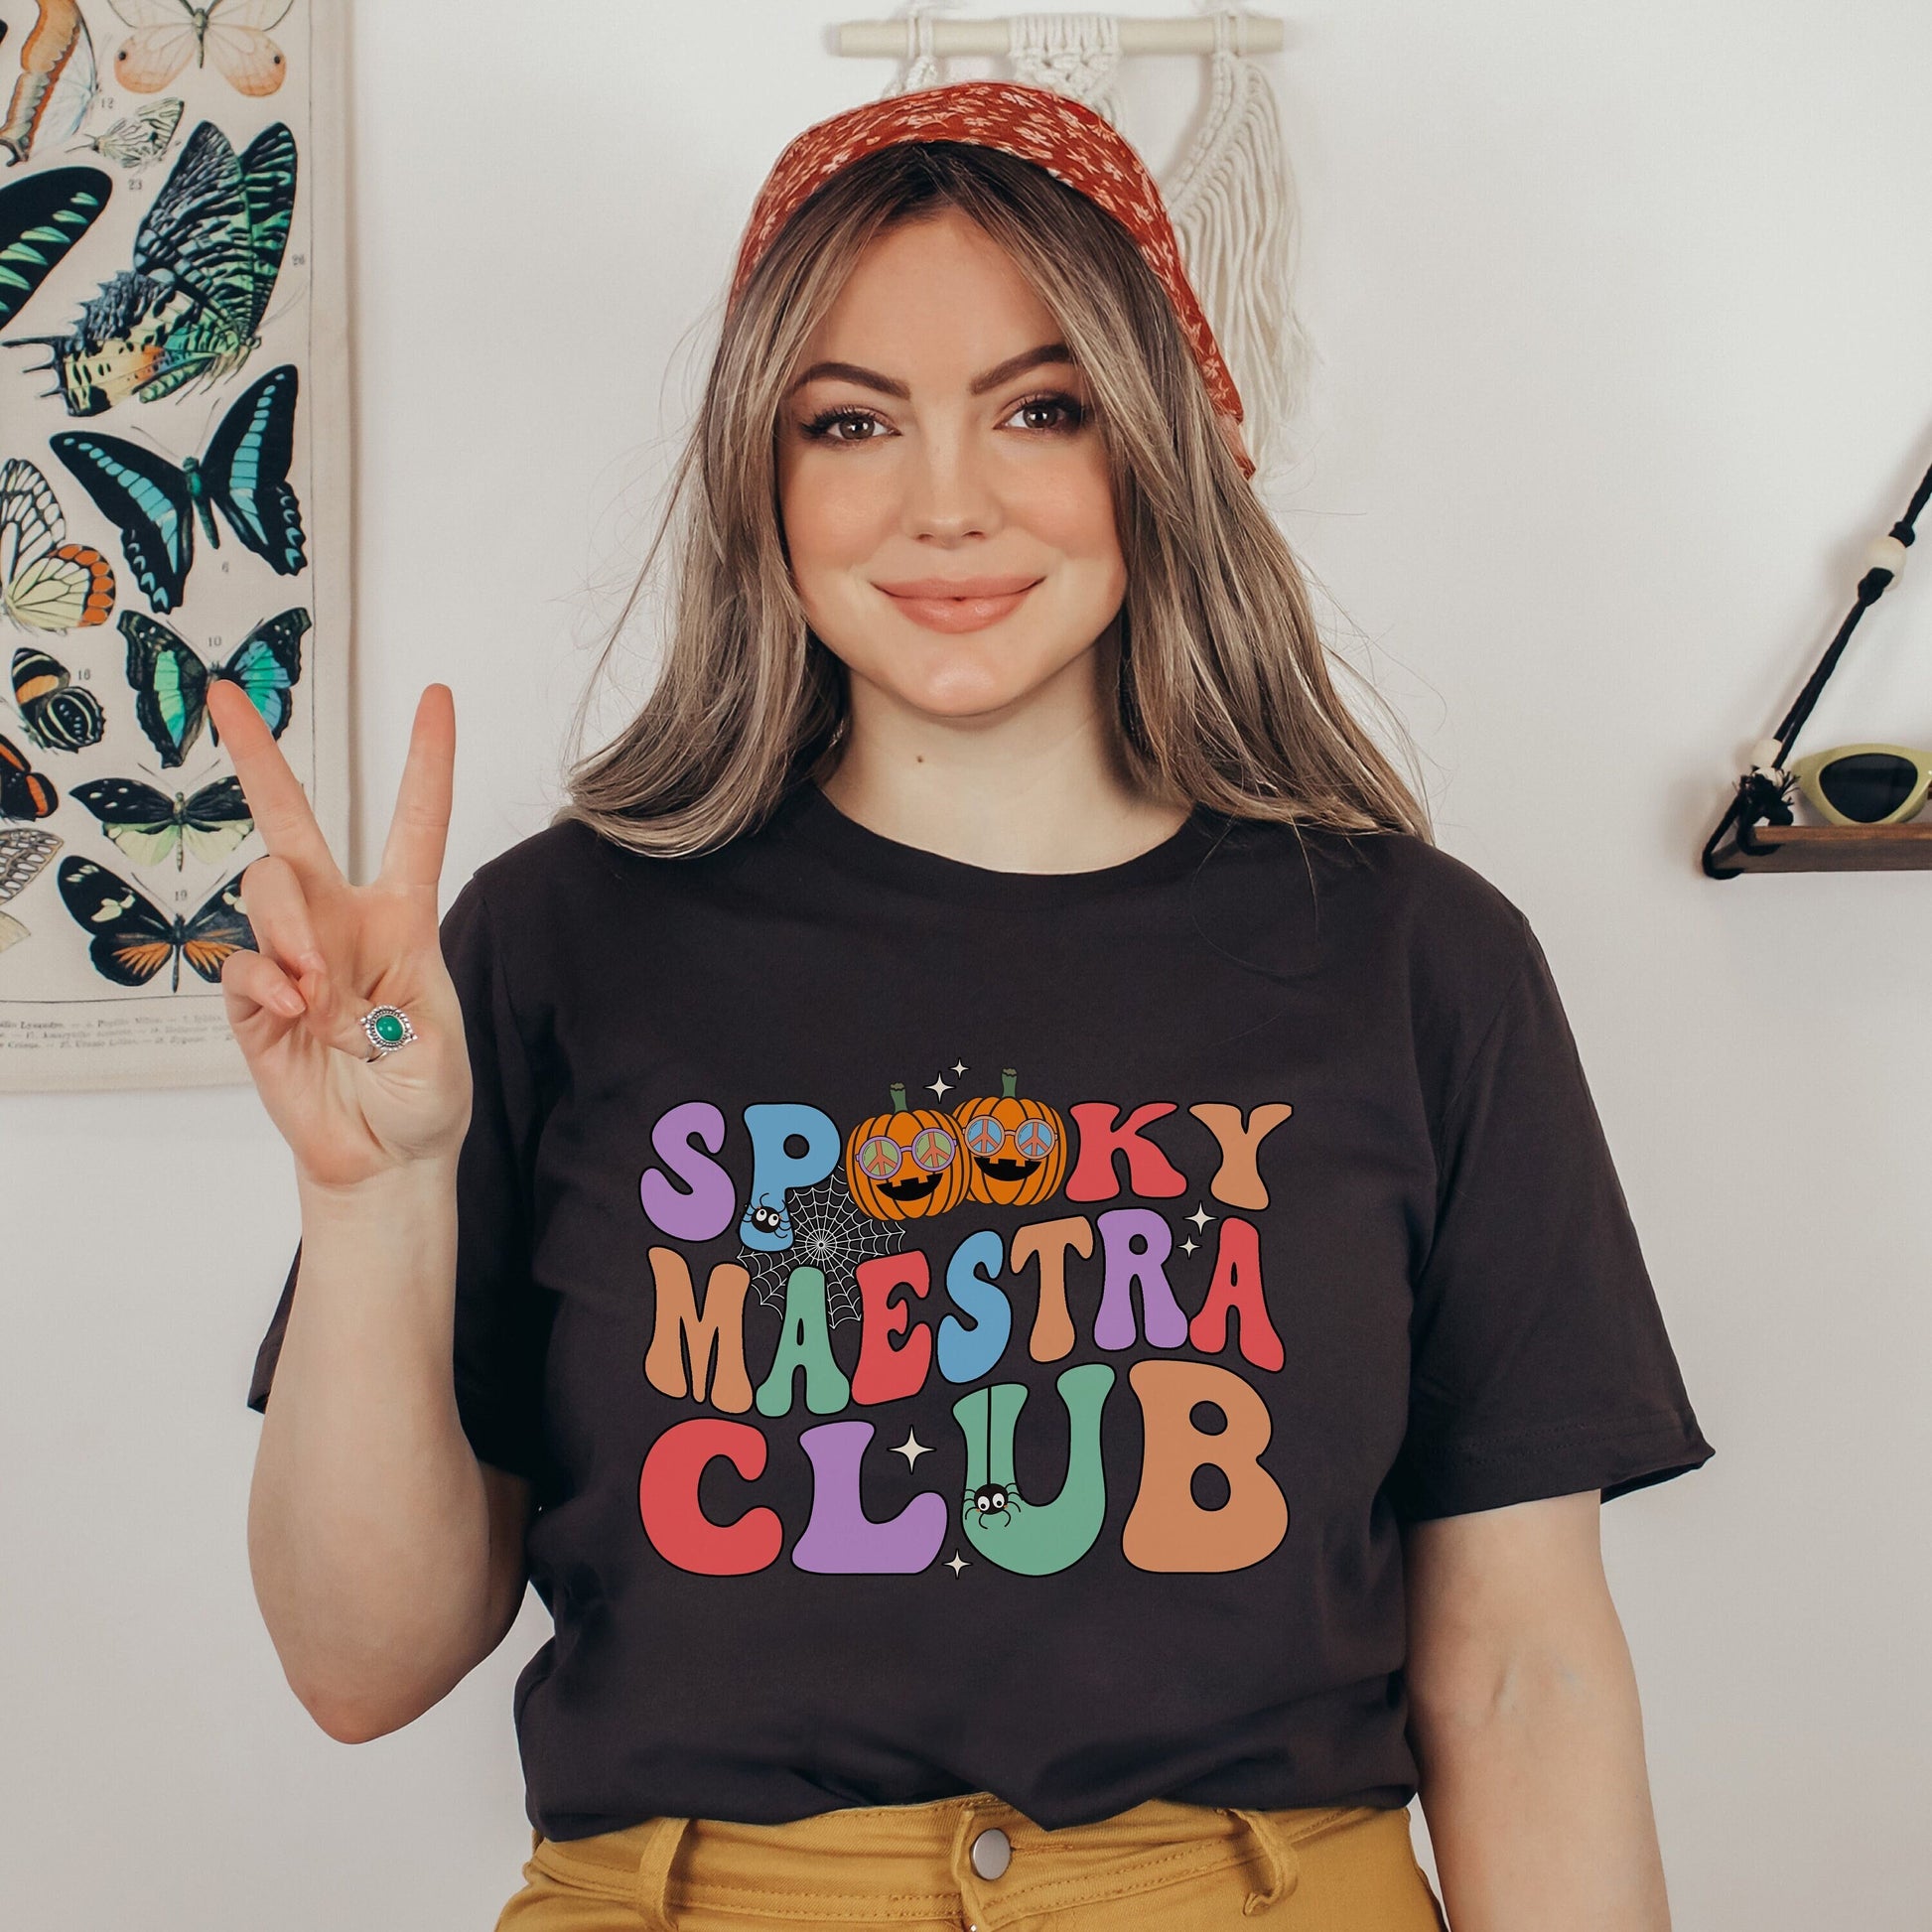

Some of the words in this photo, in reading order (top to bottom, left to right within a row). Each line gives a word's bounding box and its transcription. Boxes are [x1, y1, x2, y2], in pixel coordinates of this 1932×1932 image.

[128, 179, 143, 191] 23
[207, 636, 222, 646] 10
[643, 1207, 1286, 1419] MAESTRA
[638, 1358, 1291, 1578] CLUB
